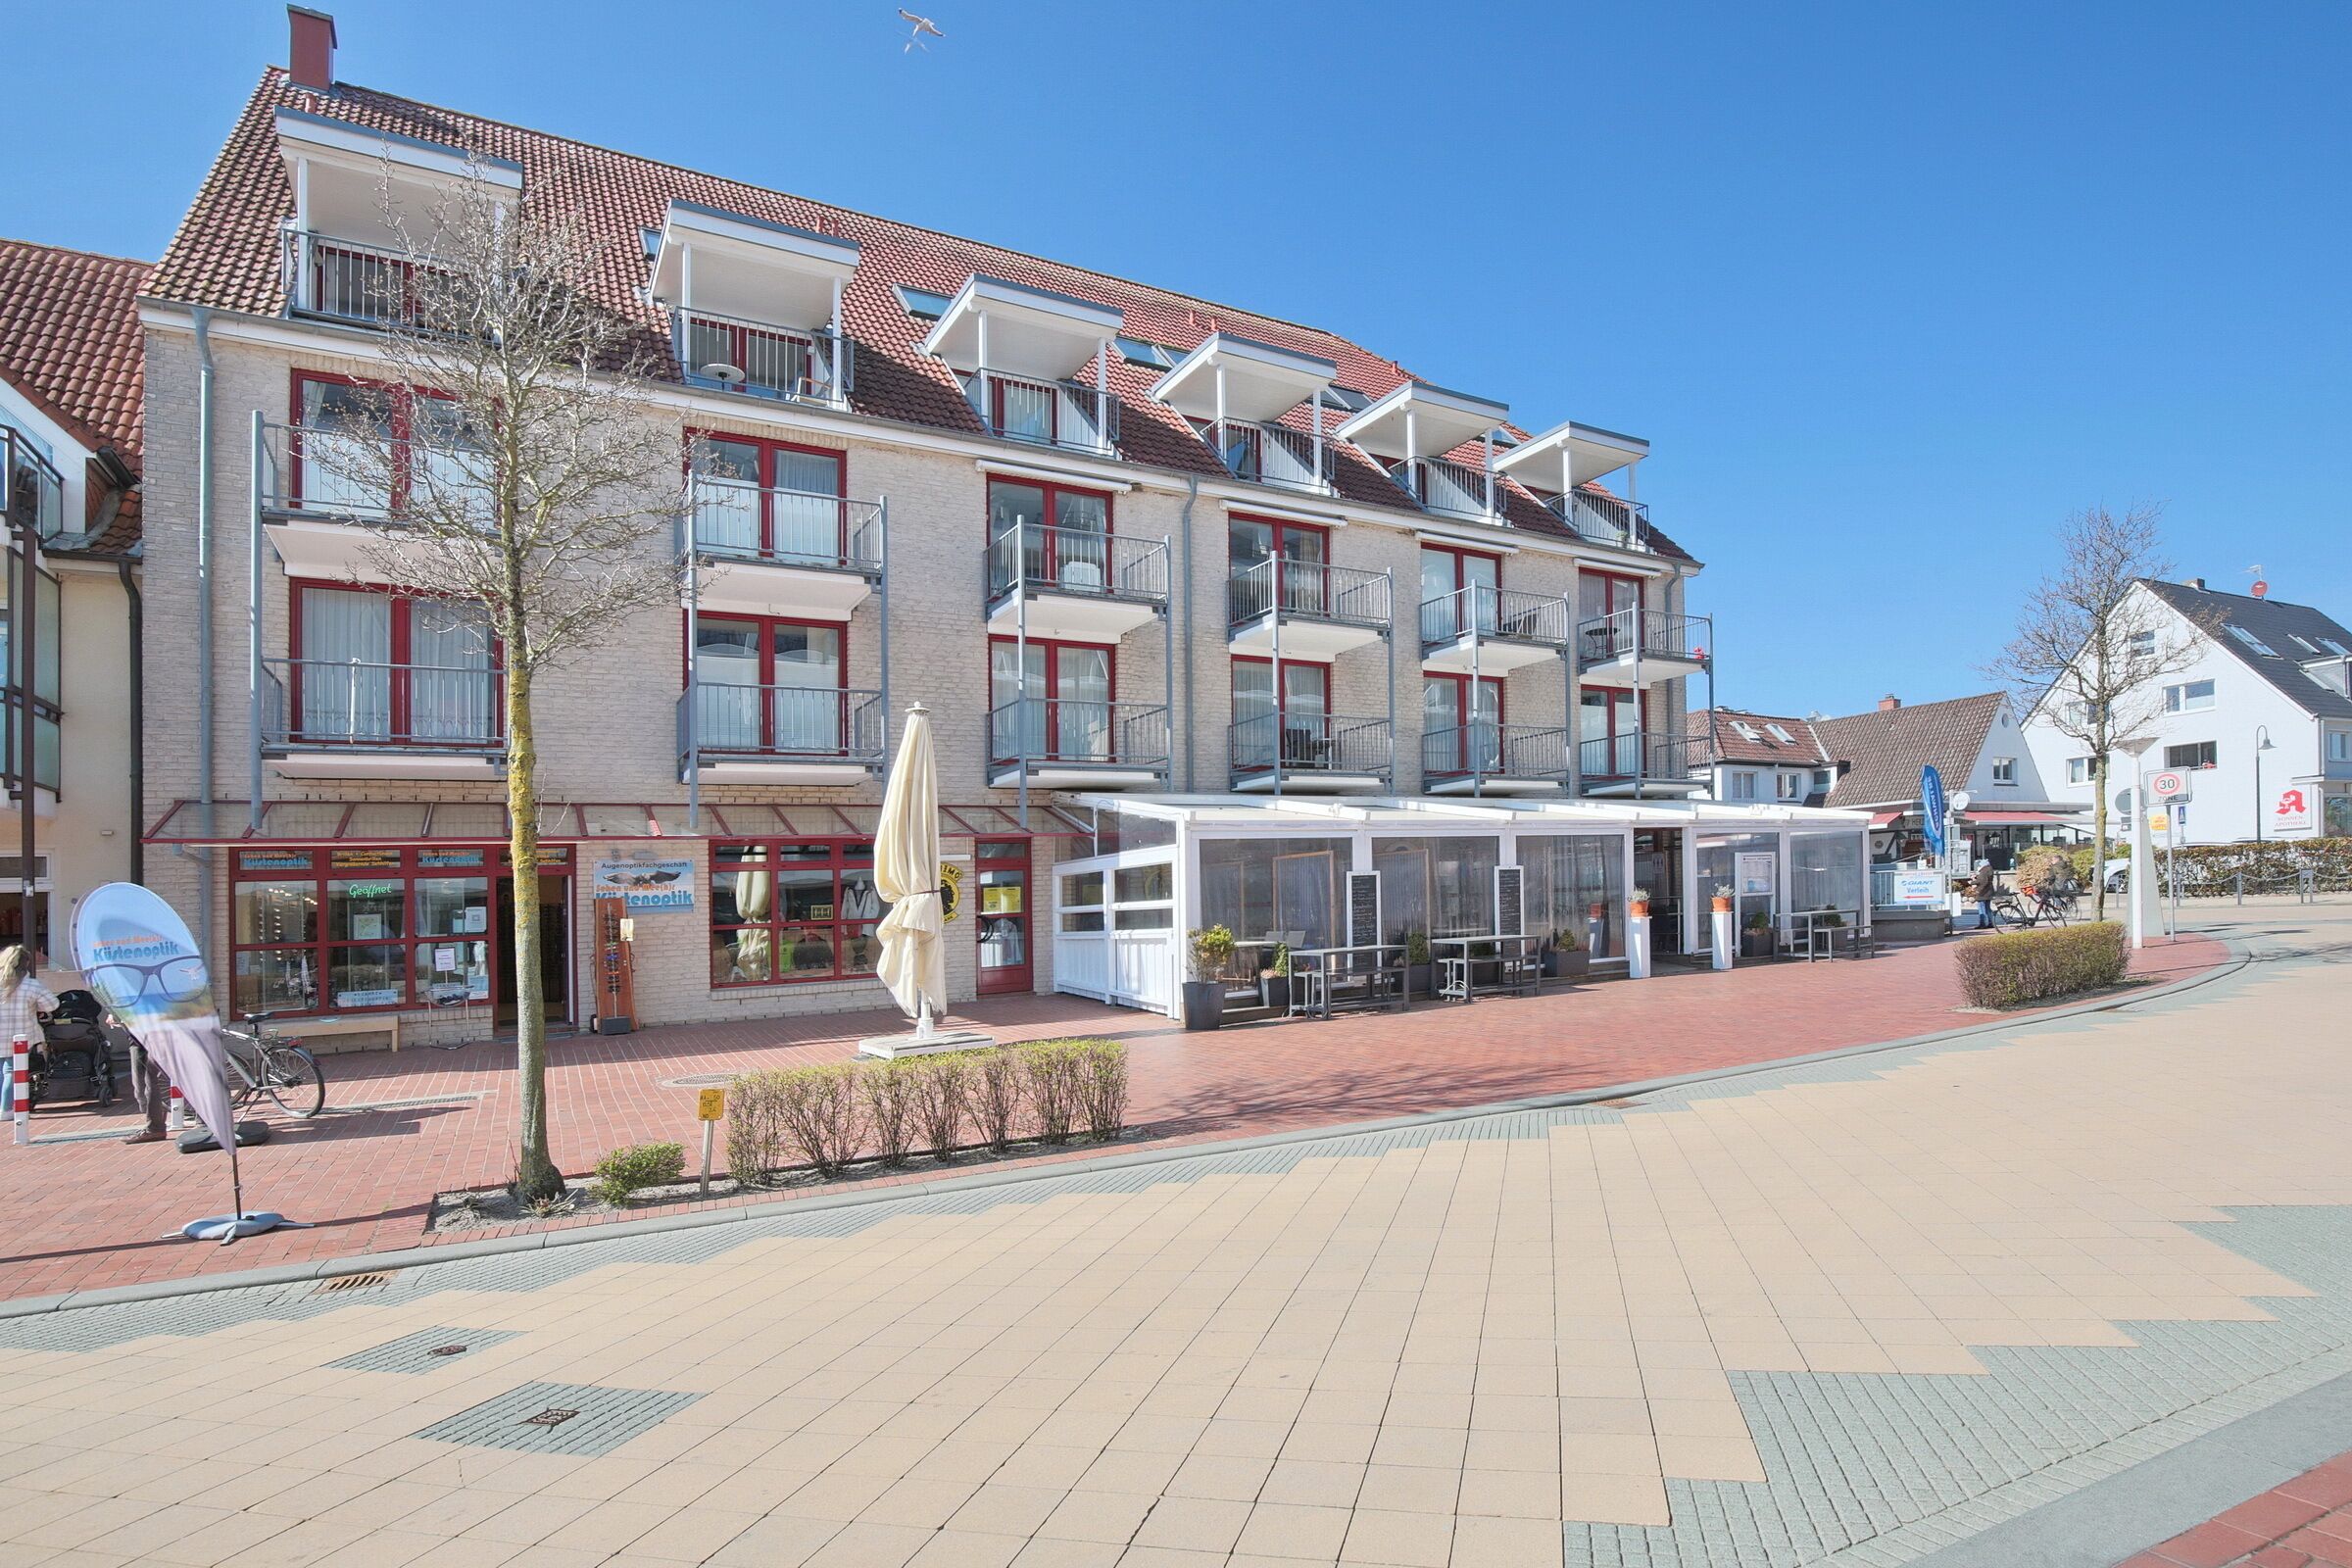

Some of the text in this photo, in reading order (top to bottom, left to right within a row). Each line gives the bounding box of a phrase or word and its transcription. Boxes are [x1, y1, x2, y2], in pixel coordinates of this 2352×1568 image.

[2159, 778, 2175, 790] 30
[601, 861, 688, 870] Augenoptikfachgeschäft
[349, 883, 392, 899] Geöffnet
[93, 941, 178, 961] Küstenoptik
